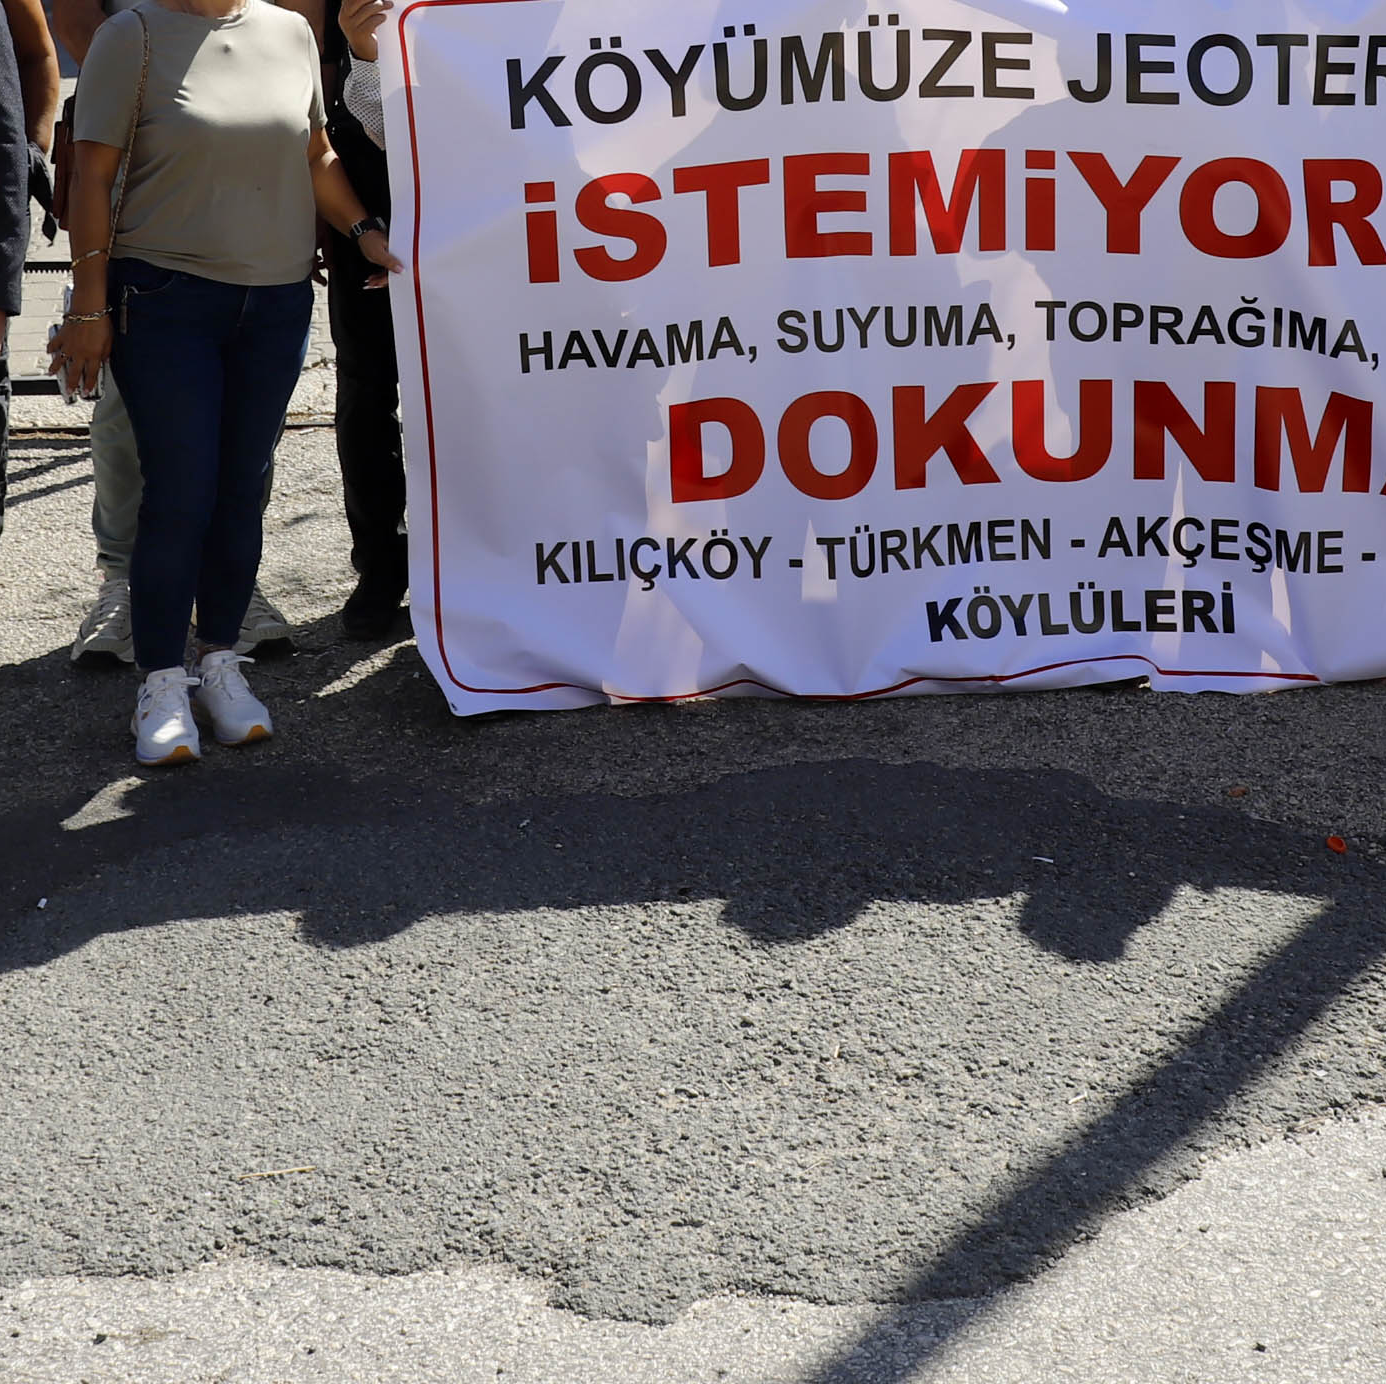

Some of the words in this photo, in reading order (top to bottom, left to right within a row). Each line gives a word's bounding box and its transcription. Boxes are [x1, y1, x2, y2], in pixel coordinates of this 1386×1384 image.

[506, 13, 1036, 130] KÖYÜMÜZE
[518, 316, 758, 374] HAVAMA,
[776, 302, 1016, 354] SUYUMA,
[1034, 295, 1381, 372] TOPRAĞIMA,
[535, 530, 773, 592] KILIÇKÖY
[815, 517, 1052, 580] TÜRKMEN
[1097, 516, 1344, 574] AKÇEŞME
[925, 581, 1236, 643] KÖYLÜLERİ
